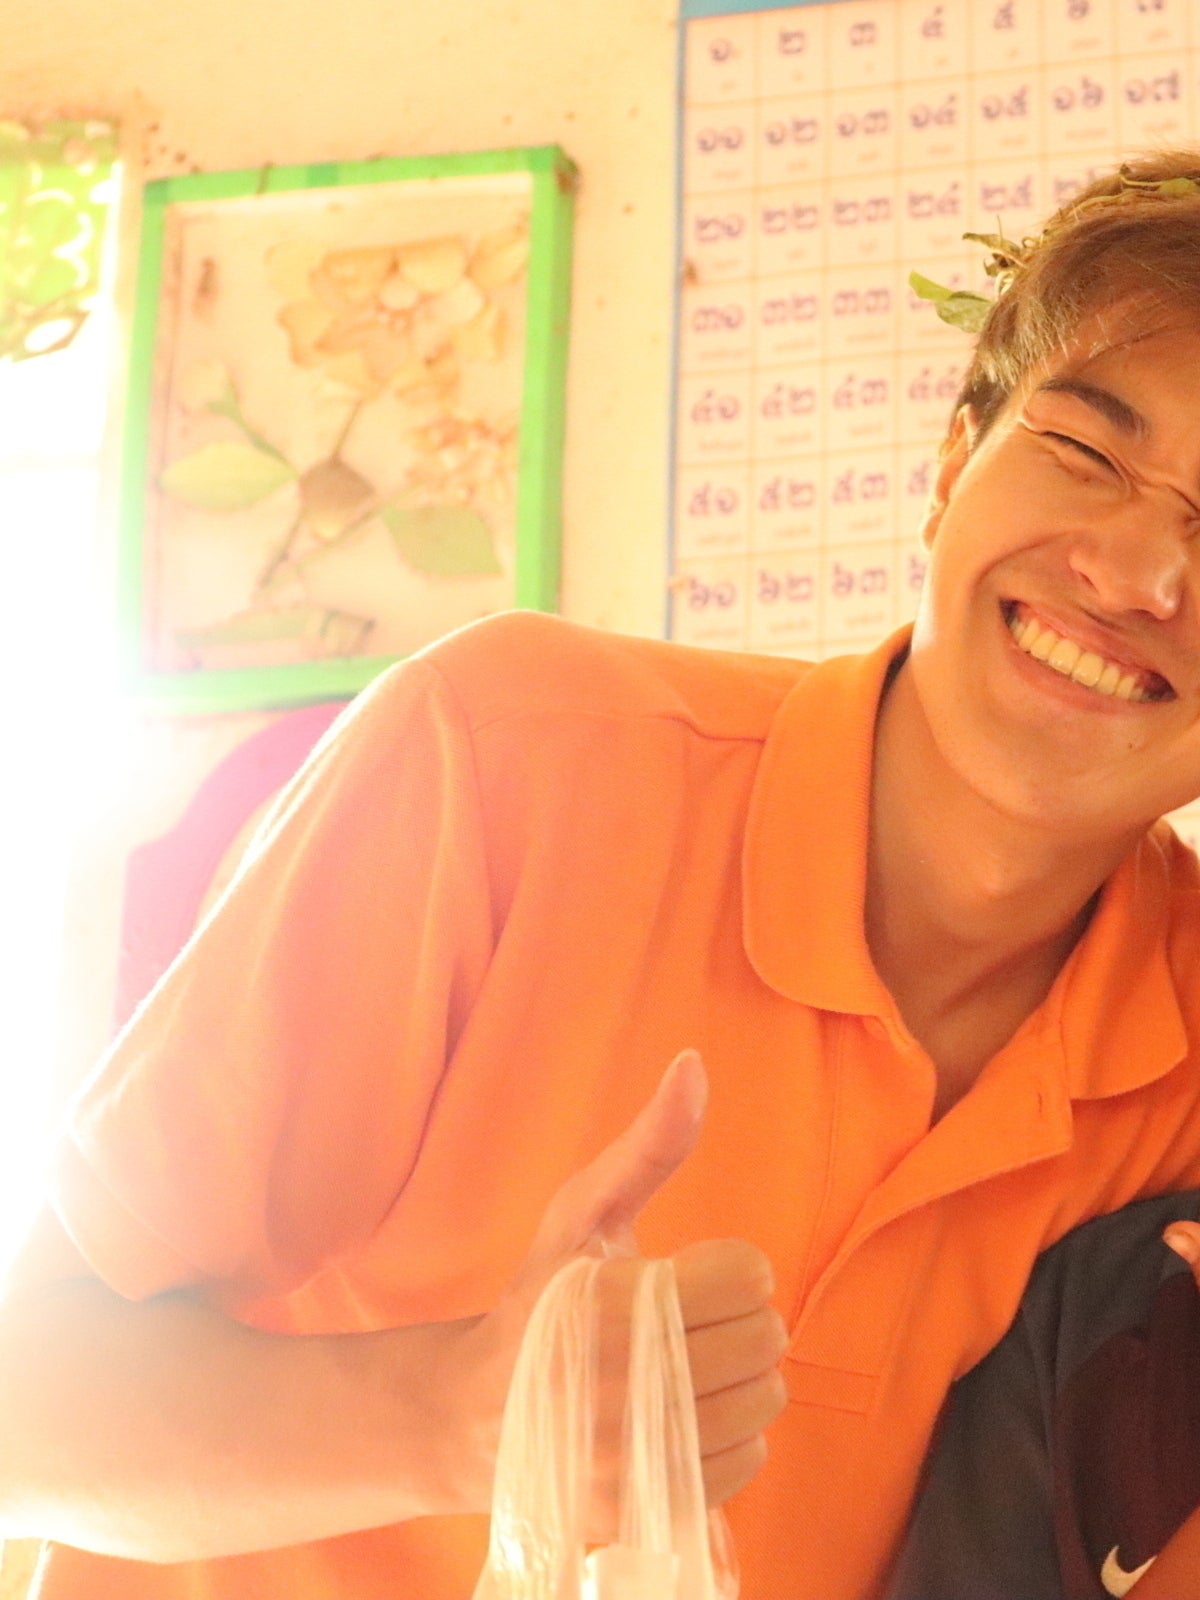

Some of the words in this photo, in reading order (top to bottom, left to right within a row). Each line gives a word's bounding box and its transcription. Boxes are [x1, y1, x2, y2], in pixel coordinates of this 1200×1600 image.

[710, 38, 733, 62] ១
[779, 30, 806, 55] ២
[850, 21, 877, 47] ៣
[921, 5, 944, 40] ៤
[697, 126, 744, 152] ១១
[764, 118, 819, 146] ១២
[836, 109, 890, 139] ១៣
[909, 93, 958, 130] ១៤
[981, 85, 1030, 120] ១៥
[1054, 76, 1104, 112] ១៦
[1125, 70, 1180, 104] ១៧
[695, 213, 745, 244] ២១
[762, 204, 819, 235] ២២
[832, 197, 891, 227] ២៣
[908, 181, 961, 220] ២៤
[981, 175, 1034, 212] ២៥
[692, 305, 745, 332] ៣១
[762, 295, 818, 325] ៣២
[834, 288, 890, 316] ៣៣
[691, 389, 741, 423] ៤១
[762, 384, 815, 418] ៤២
[833, 375, 888, 409] ៤៣
[689, 481, 739, 516] ៥១
[759, 476, 815, 511] ៥២
[833, 469, 888, 505] ៥៣
[689, 576, 736, 609] ៦១
[758, 570, 813, 604] ៦២
[832, 562, 887, 597] ៦៣
